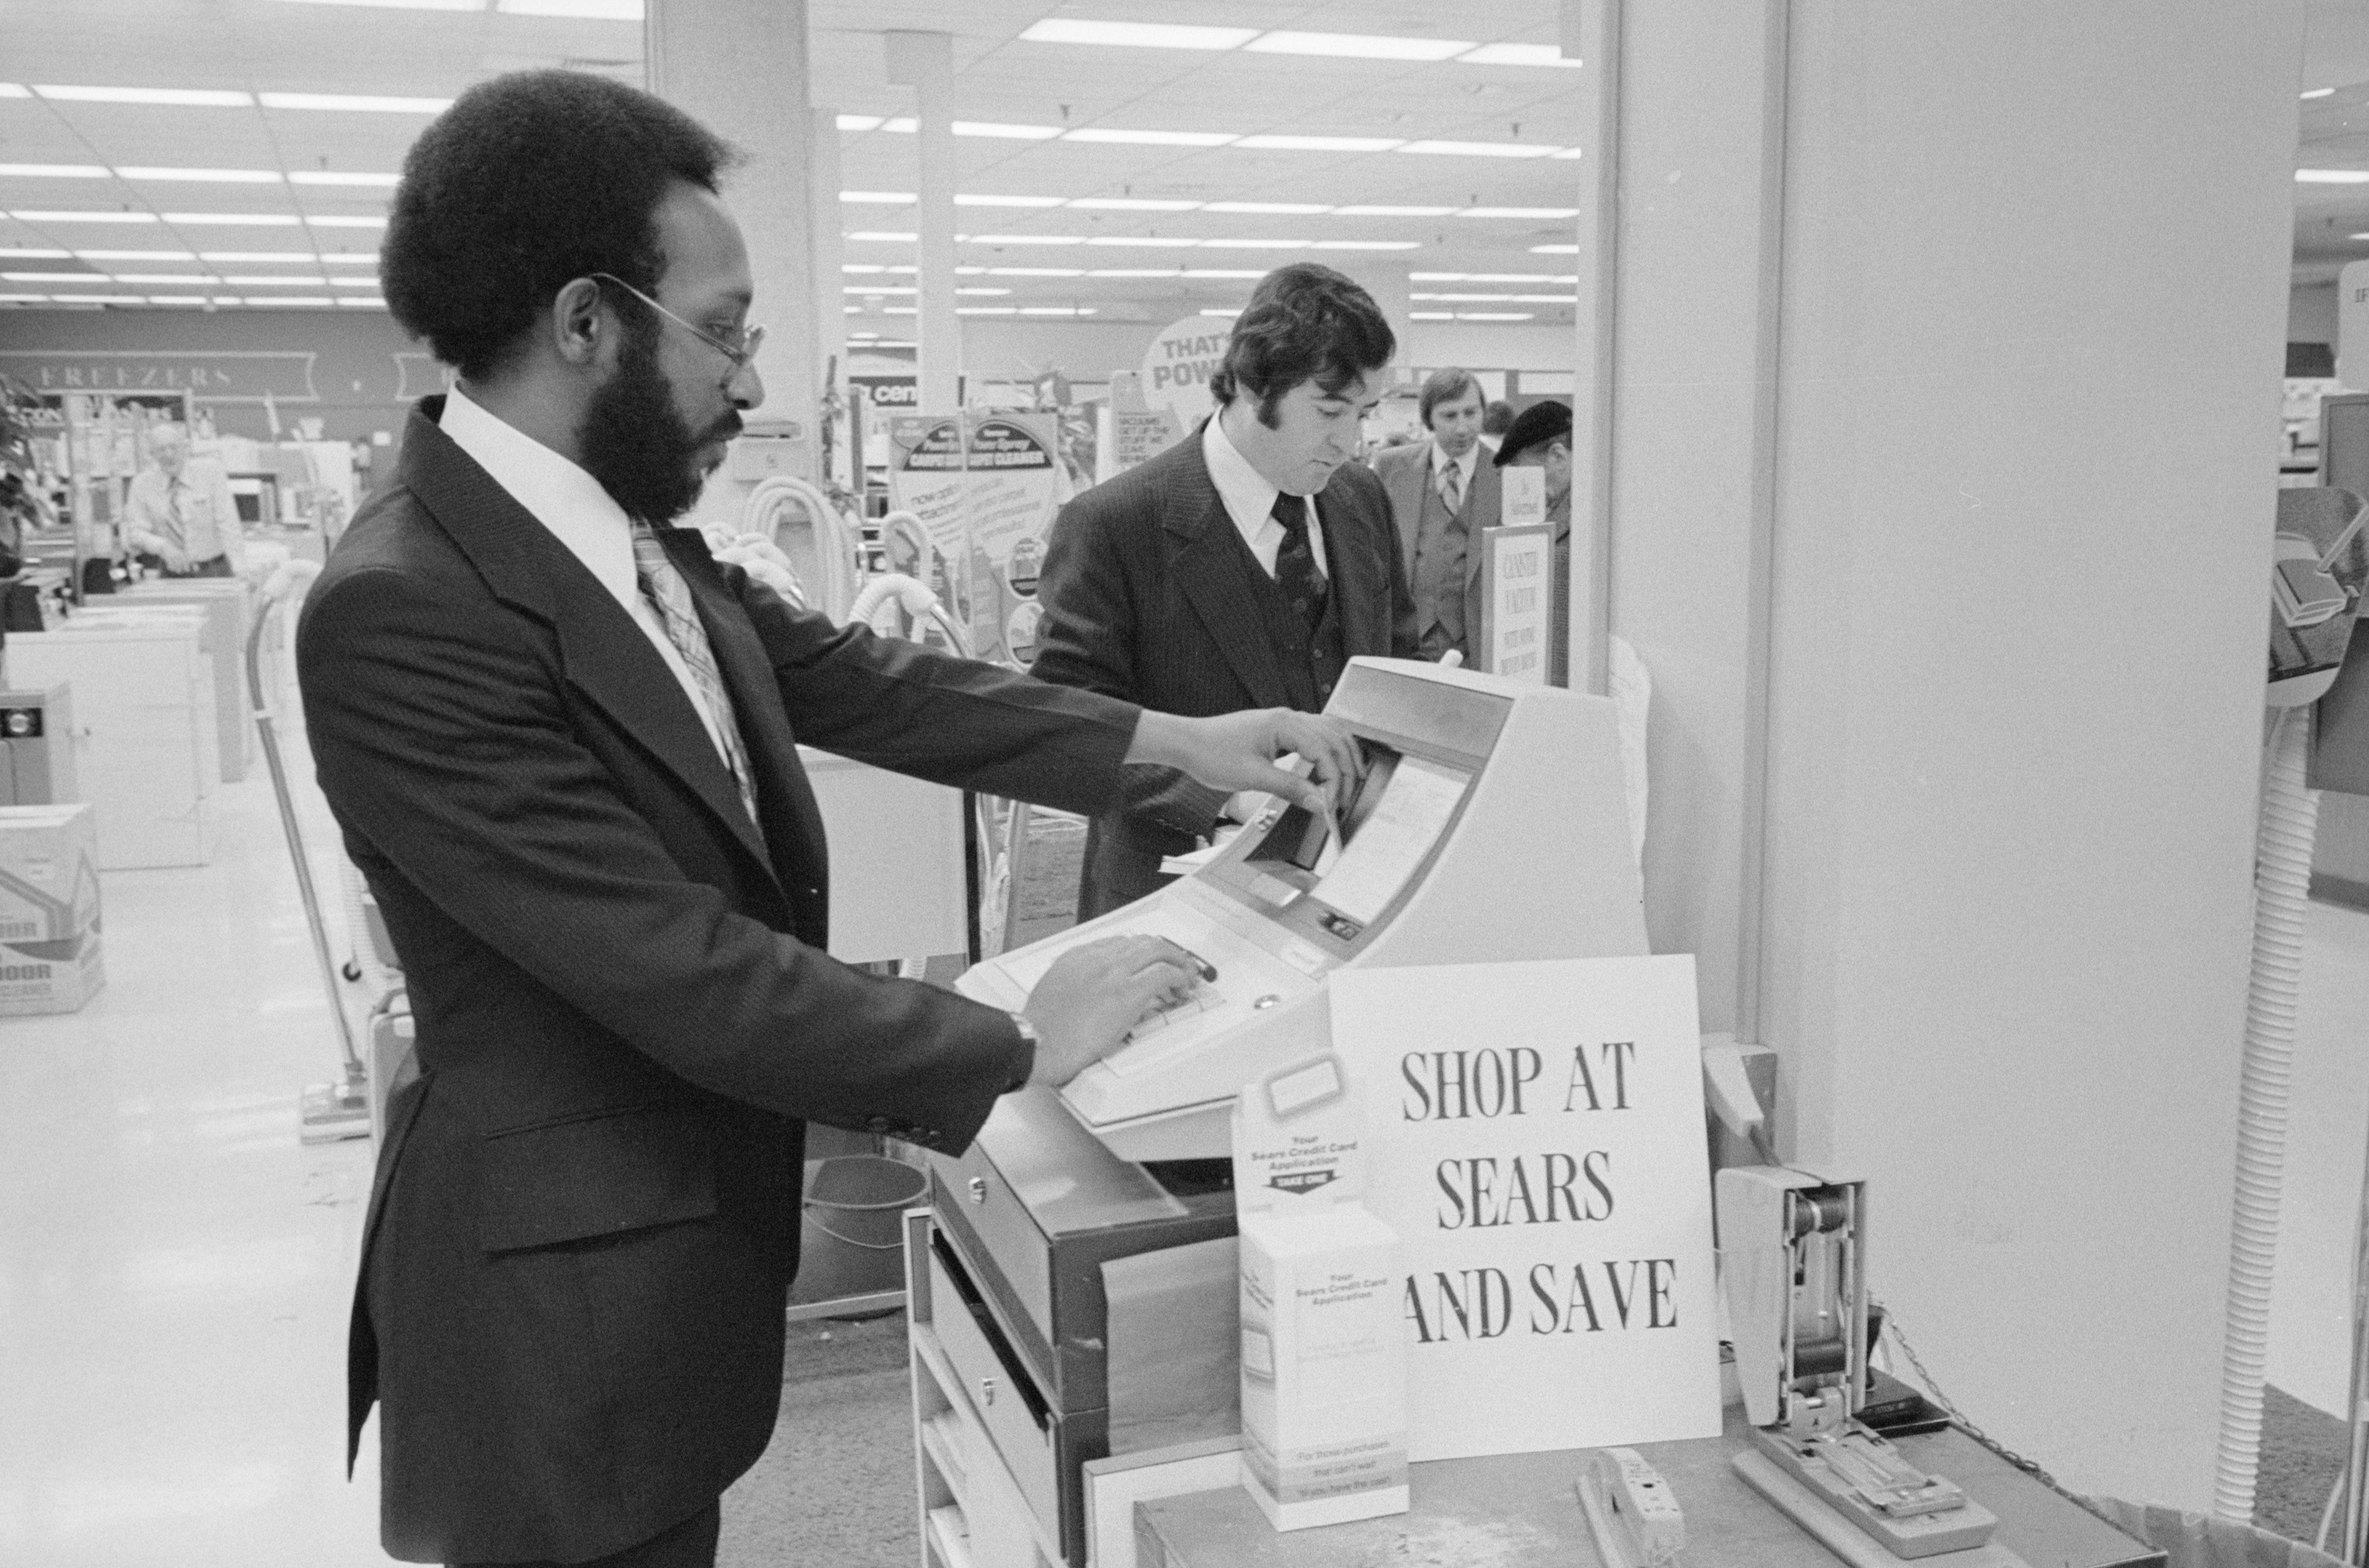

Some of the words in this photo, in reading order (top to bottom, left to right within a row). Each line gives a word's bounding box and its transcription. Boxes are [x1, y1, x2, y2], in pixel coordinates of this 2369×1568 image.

[40, 366, 231, 386] FREEZERS
[1153, 359, 1221, 390] POW
[875, 385, 916, 402] cen
[1402, 1047, 1541, 1122] SHOP
[1563, 1041, 1635, 1112] AT
[1292, 1135, 1319, 1145] Your
[1251, 1151, 1286, 1161] Sears
[1289, 1144, 1327, 1157] Credit
[1329, 1141, 1358, 1152] Card
[1269, 1156, 1339, 1170] Application
[1436, 1150, 1614, 1230] SEARS
[1296, 1288, 1325, 1298] Sears
[1328, 1281, 1360, 1293] Credit
[1363, 1277, 1388, 1288] Card
[1312, 1291, 1373, 1306] Application
[1404, 1268, 1513, 1344] AND
[1529, 1258, 1678, 1335] SAVE
